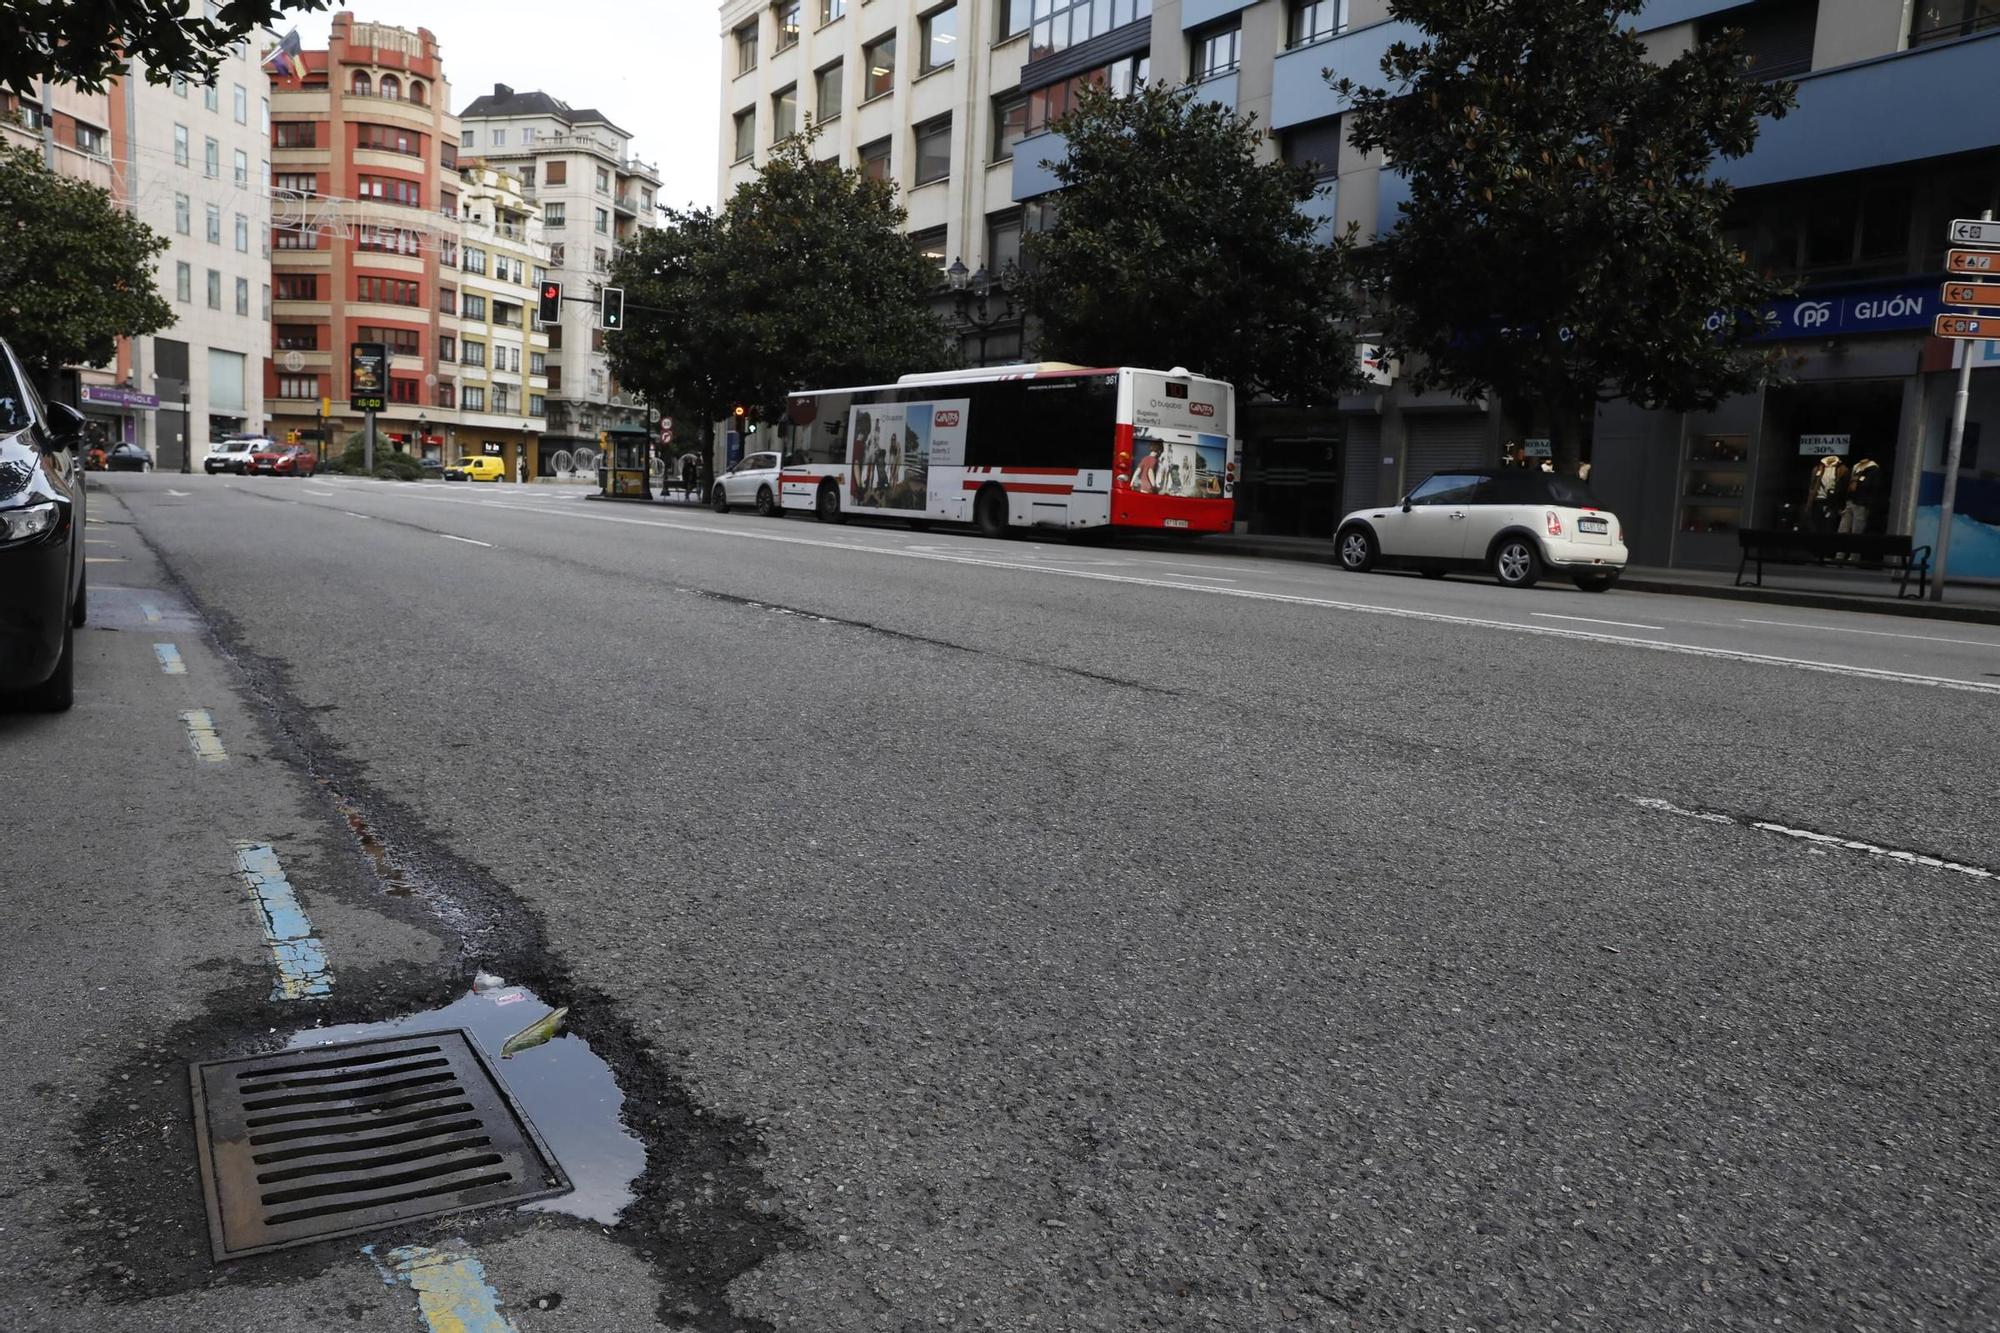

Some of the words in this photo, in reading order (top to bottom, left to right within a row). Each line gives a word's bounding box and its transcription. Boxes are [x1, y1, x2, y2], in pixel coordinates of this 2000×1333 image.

[1855, 294, 1923, 320] GIJÓN
[1969, 321, 1978, 332] P
[1105, 375, 1118, 386] 361
[1525, 440, 1551, 448] REBAJ
[1801, 436, 1849, 445] REBAJAS
